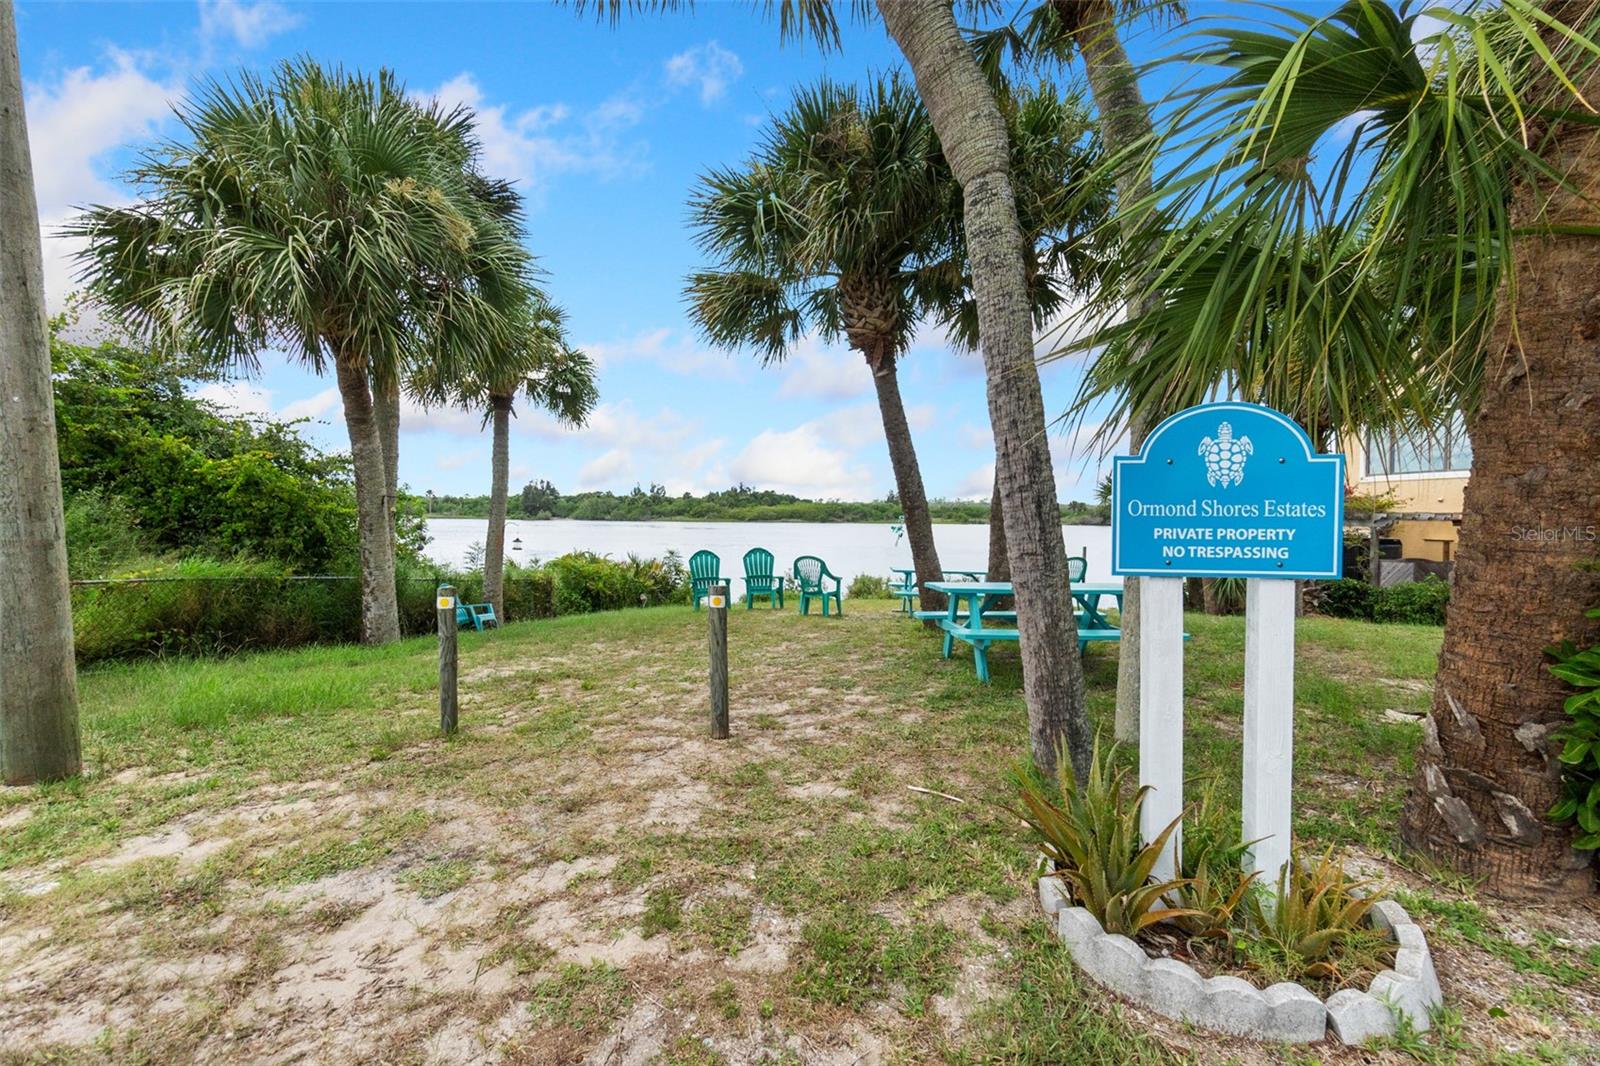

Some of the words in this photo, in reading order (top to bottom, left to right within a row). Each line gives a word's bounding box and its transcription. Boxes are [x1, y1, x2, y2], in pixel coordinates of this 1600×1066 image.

[1128, 499, 1196, 517] Ormond
[1201, 499, 1259, 517] Shores
[1263, 499, 1326, 518] Estates
[1153, 528, 1213, 540] PRIVATE
[1217, 528, 1296, 541] PROPERTY
[1162, 546, 1185, 558] NO
[1188, 546, 1289, 559] TRESPASSING
